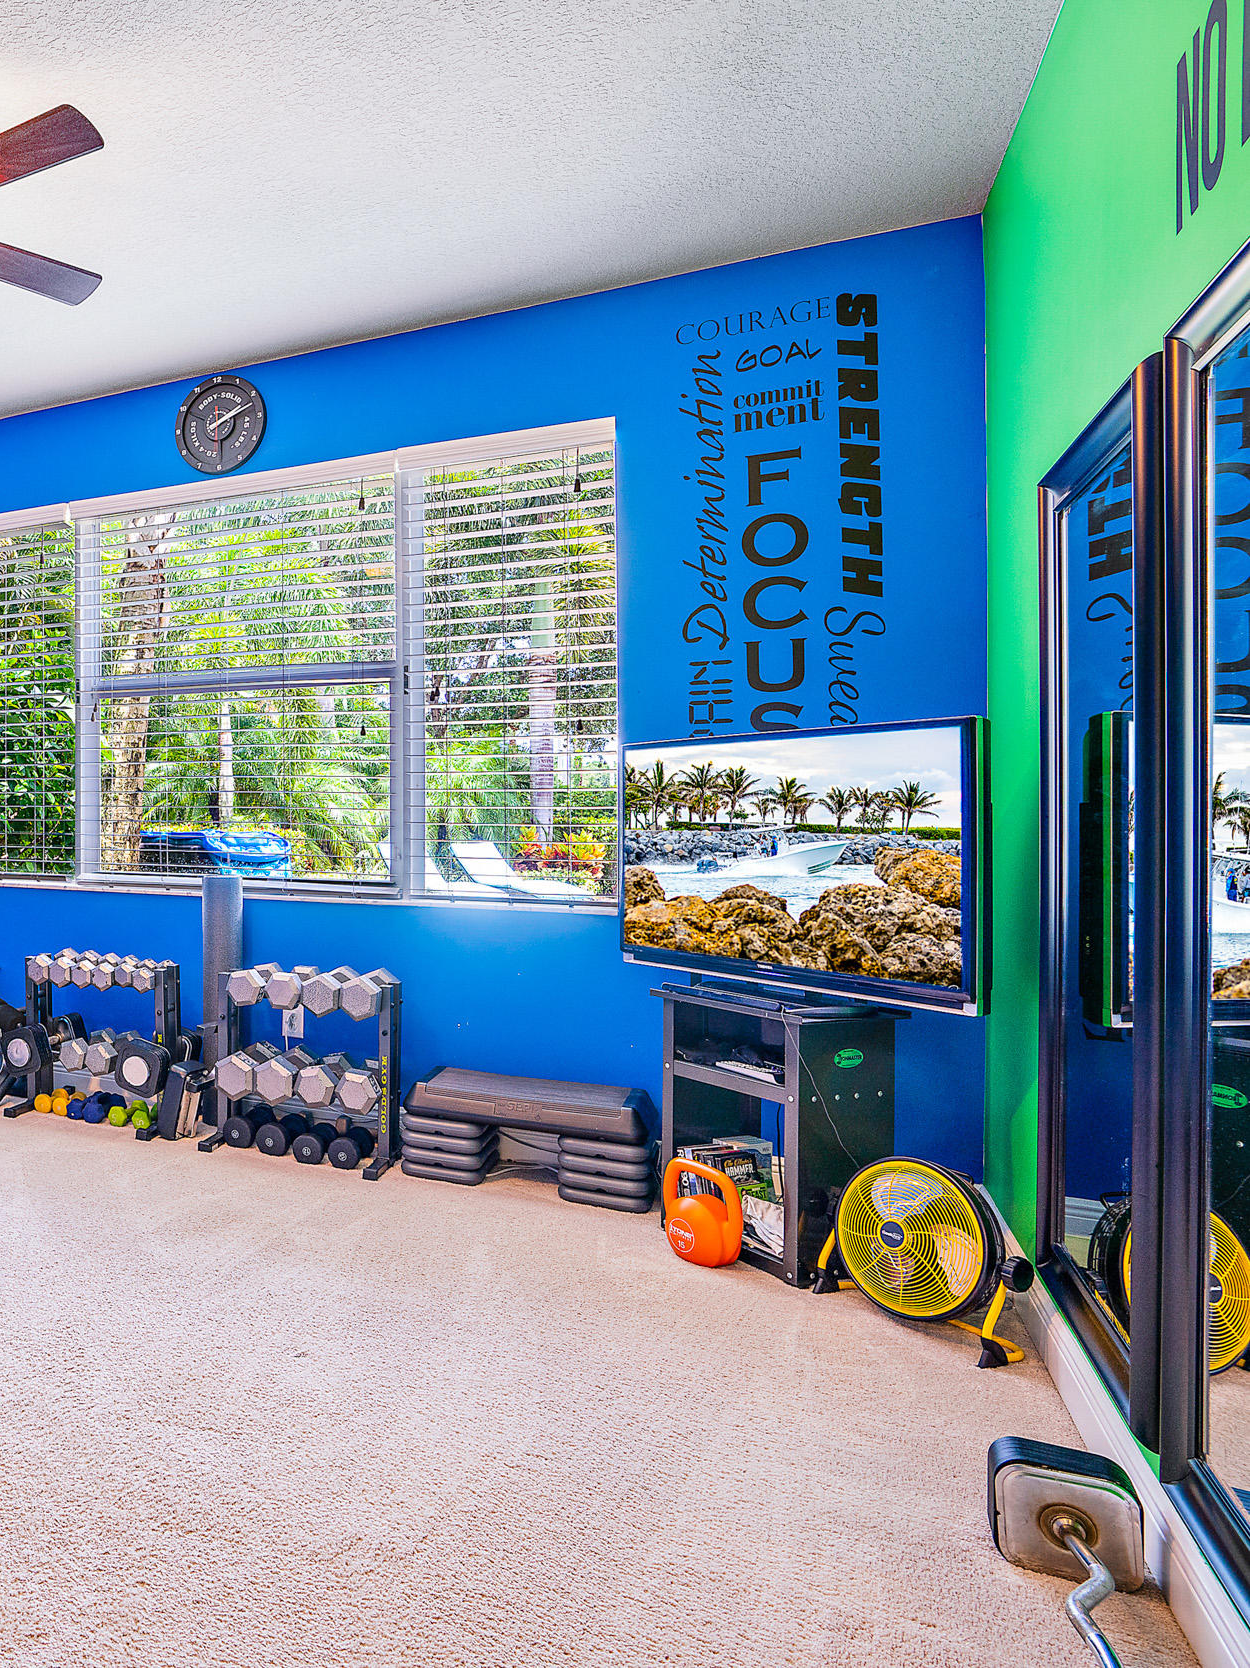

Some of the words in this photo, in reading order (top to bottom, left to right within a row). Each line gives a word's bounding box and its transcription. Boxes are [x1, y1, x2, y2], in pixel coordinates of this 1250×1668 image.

[1176, 0, 1228, 236] NO
[676, 296, 831, 345] COURAGE
[735, 339, 822, 373] GOAL
[198, 391, 242, 411] BODY-SOLID
[212, 376, 223, 384] 12
[733, 379, 825, 410] commit
[733, 399, 826, 434] ment
[836, 292, 884, 598] STRENGTH
[680, 349, 731, 651] Determination
[741, 446, 810, 730] FOCUS
